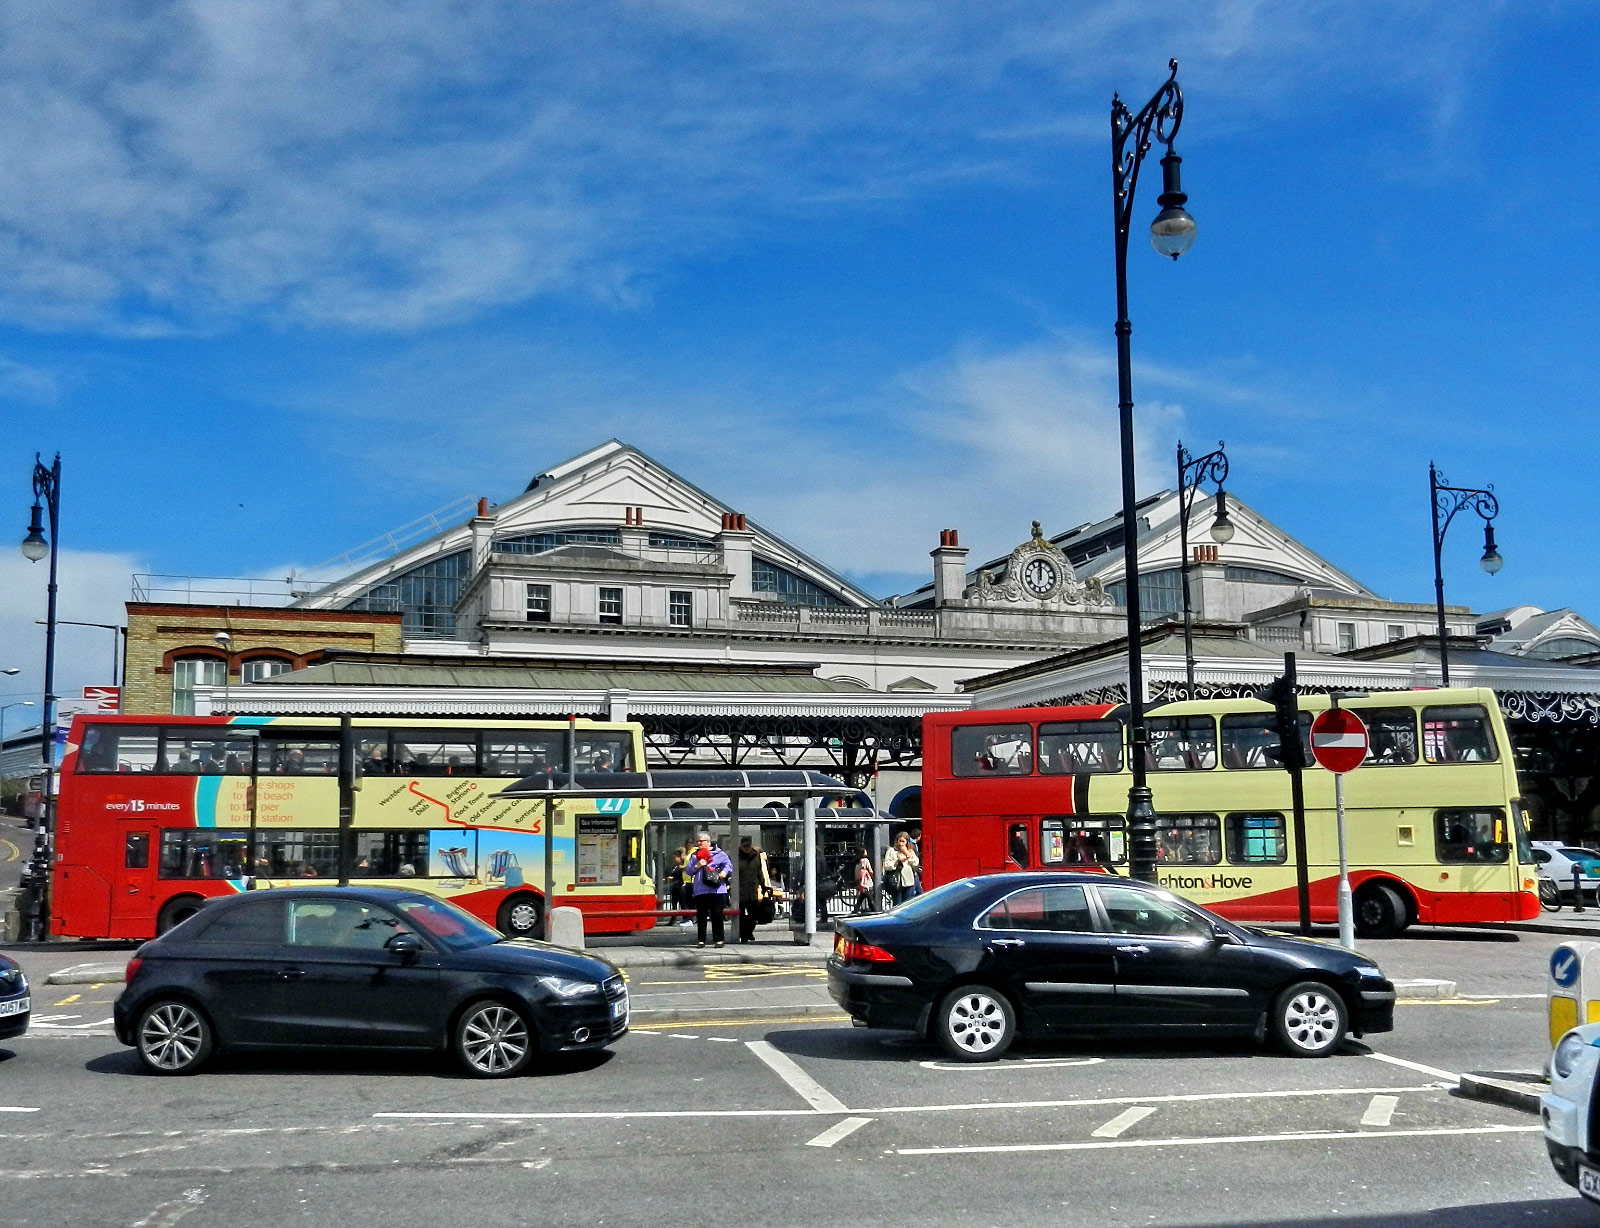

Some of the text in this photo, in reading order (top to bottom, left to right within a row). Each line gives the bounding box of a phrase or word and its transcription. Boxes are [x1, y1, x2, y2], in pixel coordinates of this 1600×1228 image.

[236, 781, 245, 789] to
[266, 781, 295, 791] shops
[446, 779, 469, 800] Brighton
[233, 792, 242, 800] to
[263, 792, 293, 800] beach
[379, 784, 407, 806] Westdene
[450, 787, 471, 805] Station
[106, 800, 180, 812] every 15 minutes
[230, 803, 239, 811] to
[261, 803, 279, 813] pier
[408, 798, 425, 813] Seven
[415, 804, 430, 816] Dials
[453, 791, 485, 819] Clock Tower
[469, 799, 497, 823] Old Steine
[261, 814, 293, 822] station
[492, 805, 512, 823] Marine
